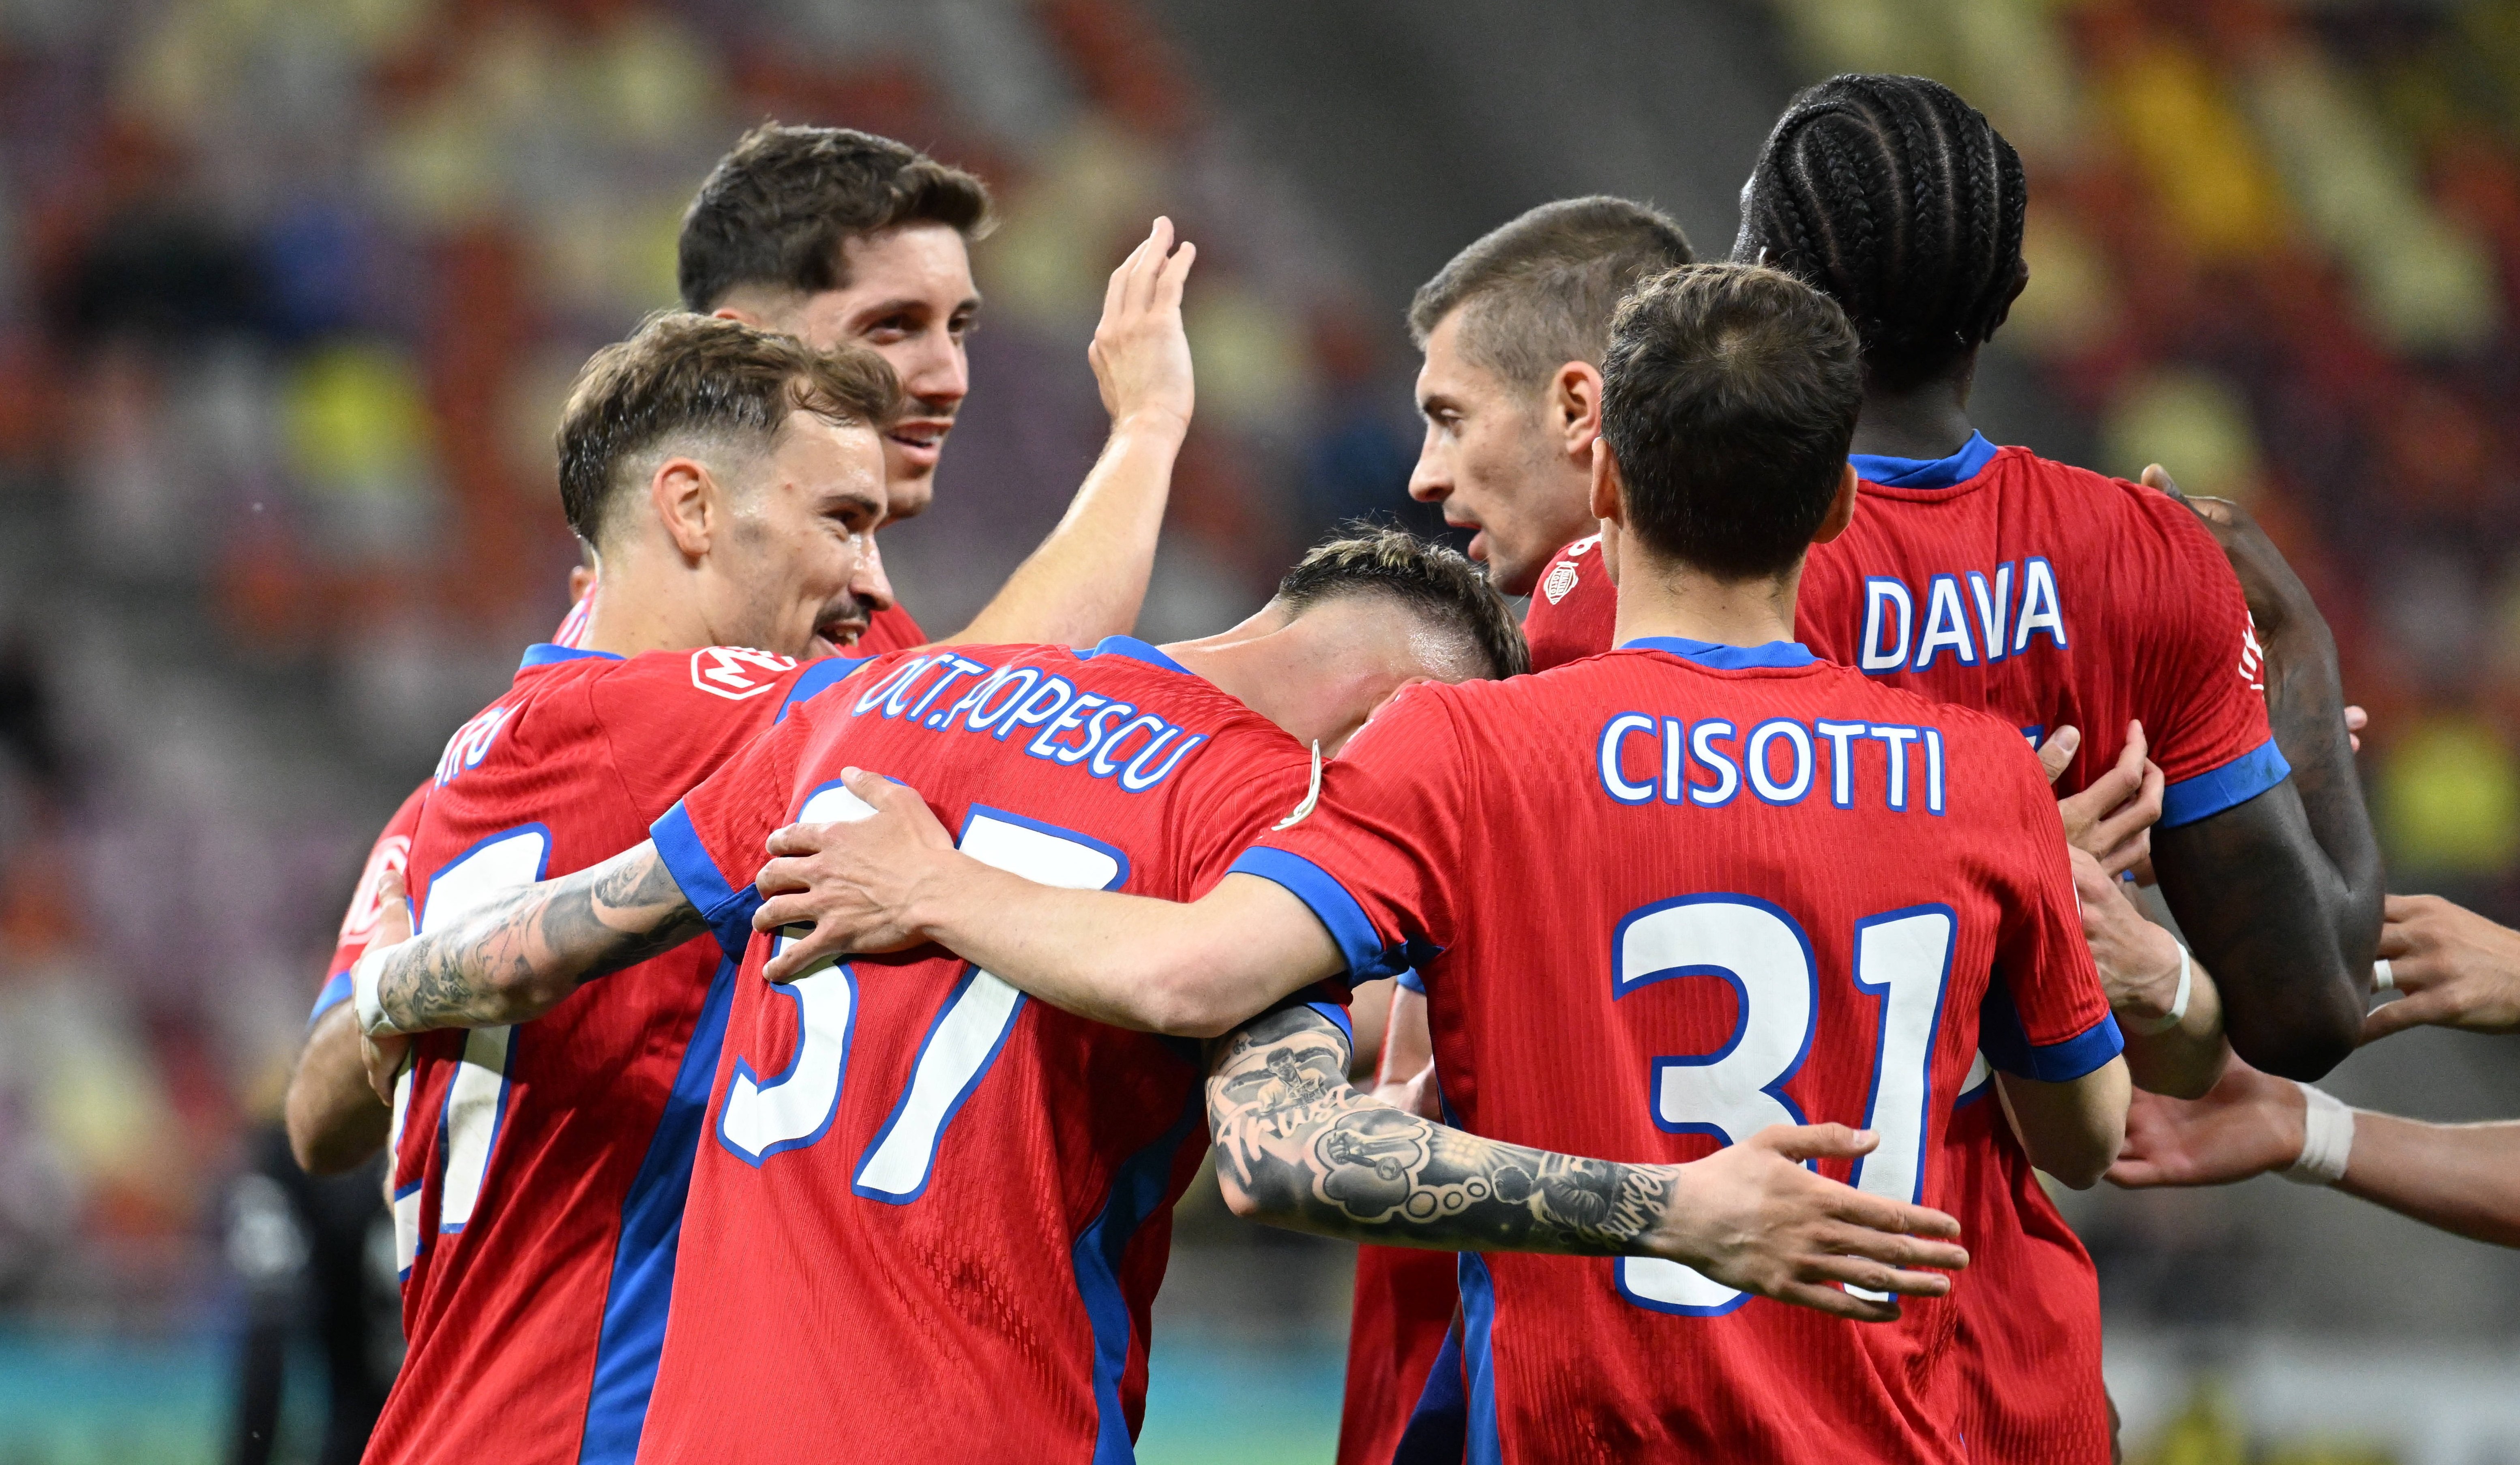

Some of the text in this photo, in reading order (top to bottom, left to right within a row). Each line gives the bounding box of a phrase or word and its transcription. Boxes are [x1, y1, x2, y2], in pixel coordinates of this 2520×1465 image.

[851, 652, 1210, 794] OCT.POPESCU
[1596, 710, 1945, 817] CISOTTI
[716, 776, 1131, 1205] 37
[1612, 892, 1958, 1316] 31
